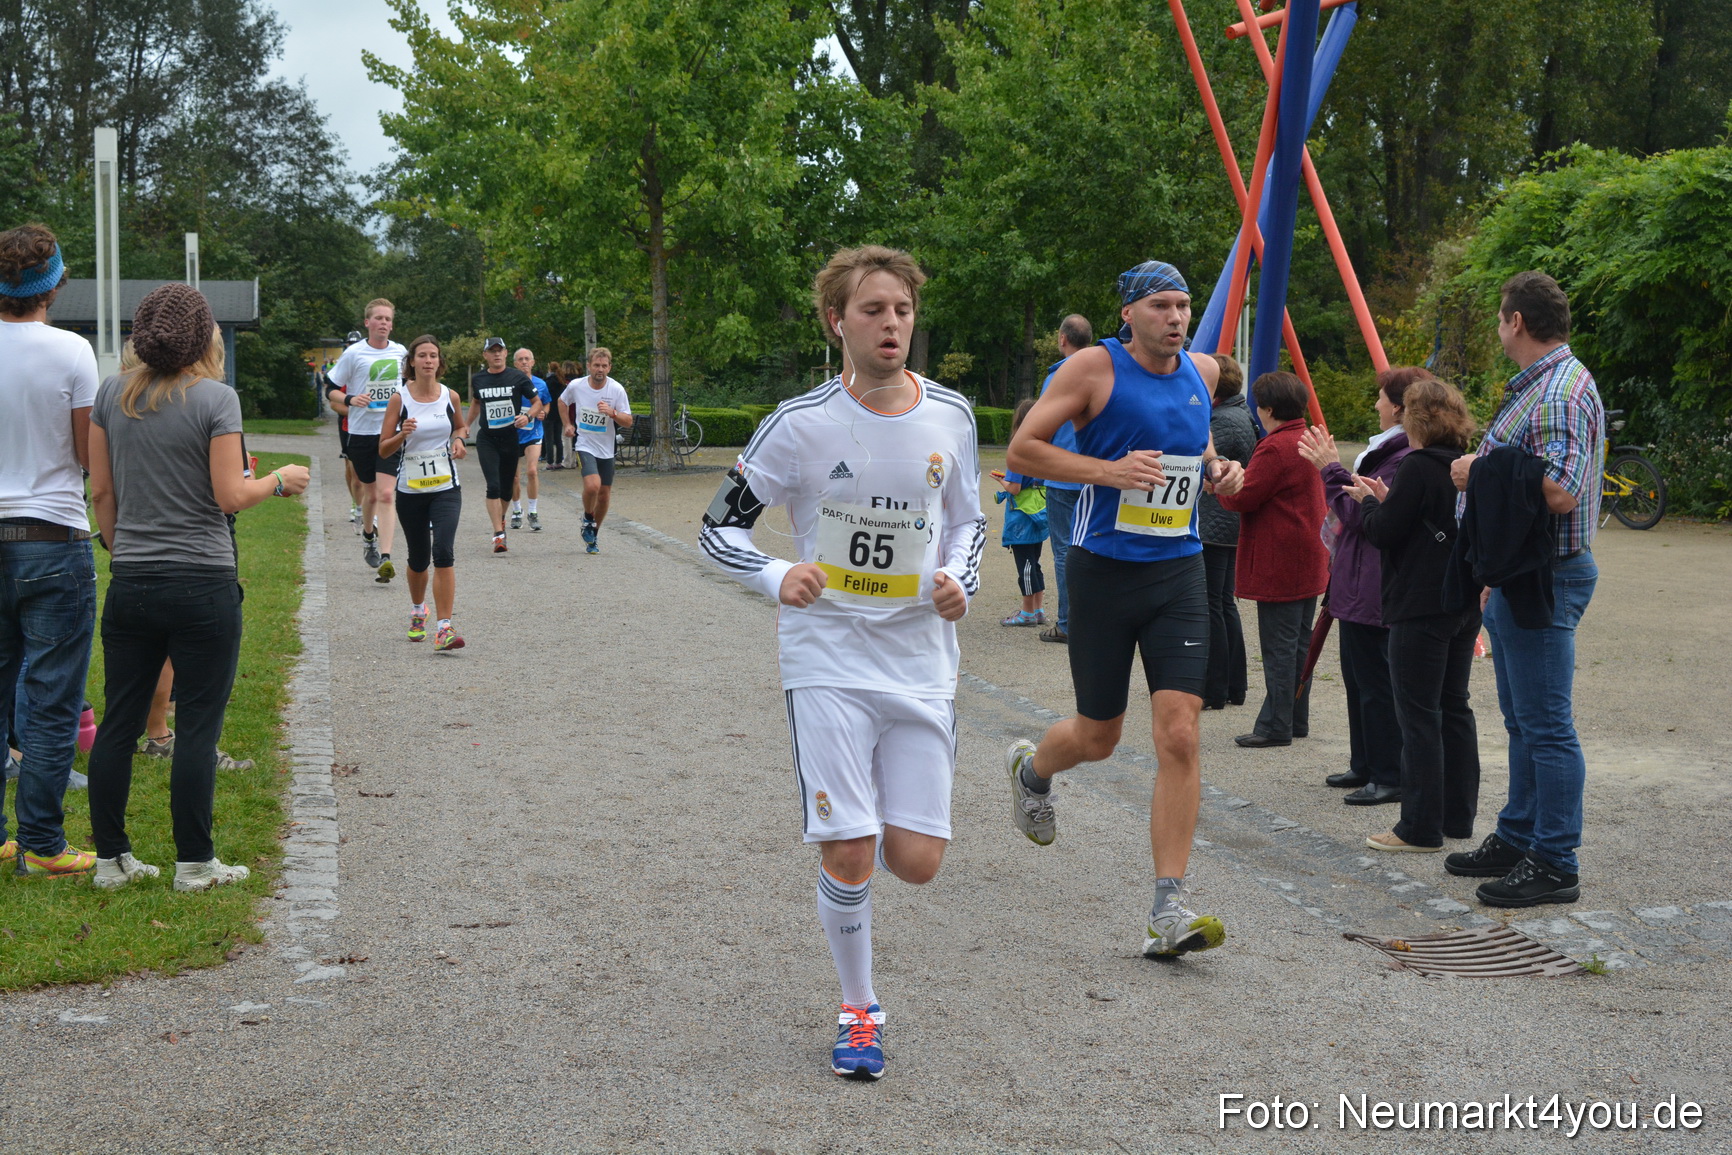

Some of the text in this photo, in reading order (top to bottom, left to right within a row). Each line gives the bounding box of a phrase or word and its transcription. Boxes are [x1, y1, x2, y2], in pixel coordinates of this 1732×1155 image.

[479, 386, 513, 398] THULE
[490, 406, 513, 418] 2079
[582, 413, 606, 425] 3374
[419, 460, 436, 476] 11
[829, 472, 853, 480] adidas
[822, 507, 911, 529] PARTL Neumarkt
[1150, 512, 1173, 525] Uwe
[849, 531, 895, 569] 65
[844, 574, 889, 595] Felipe
[840, 922, 862, 934] RM
